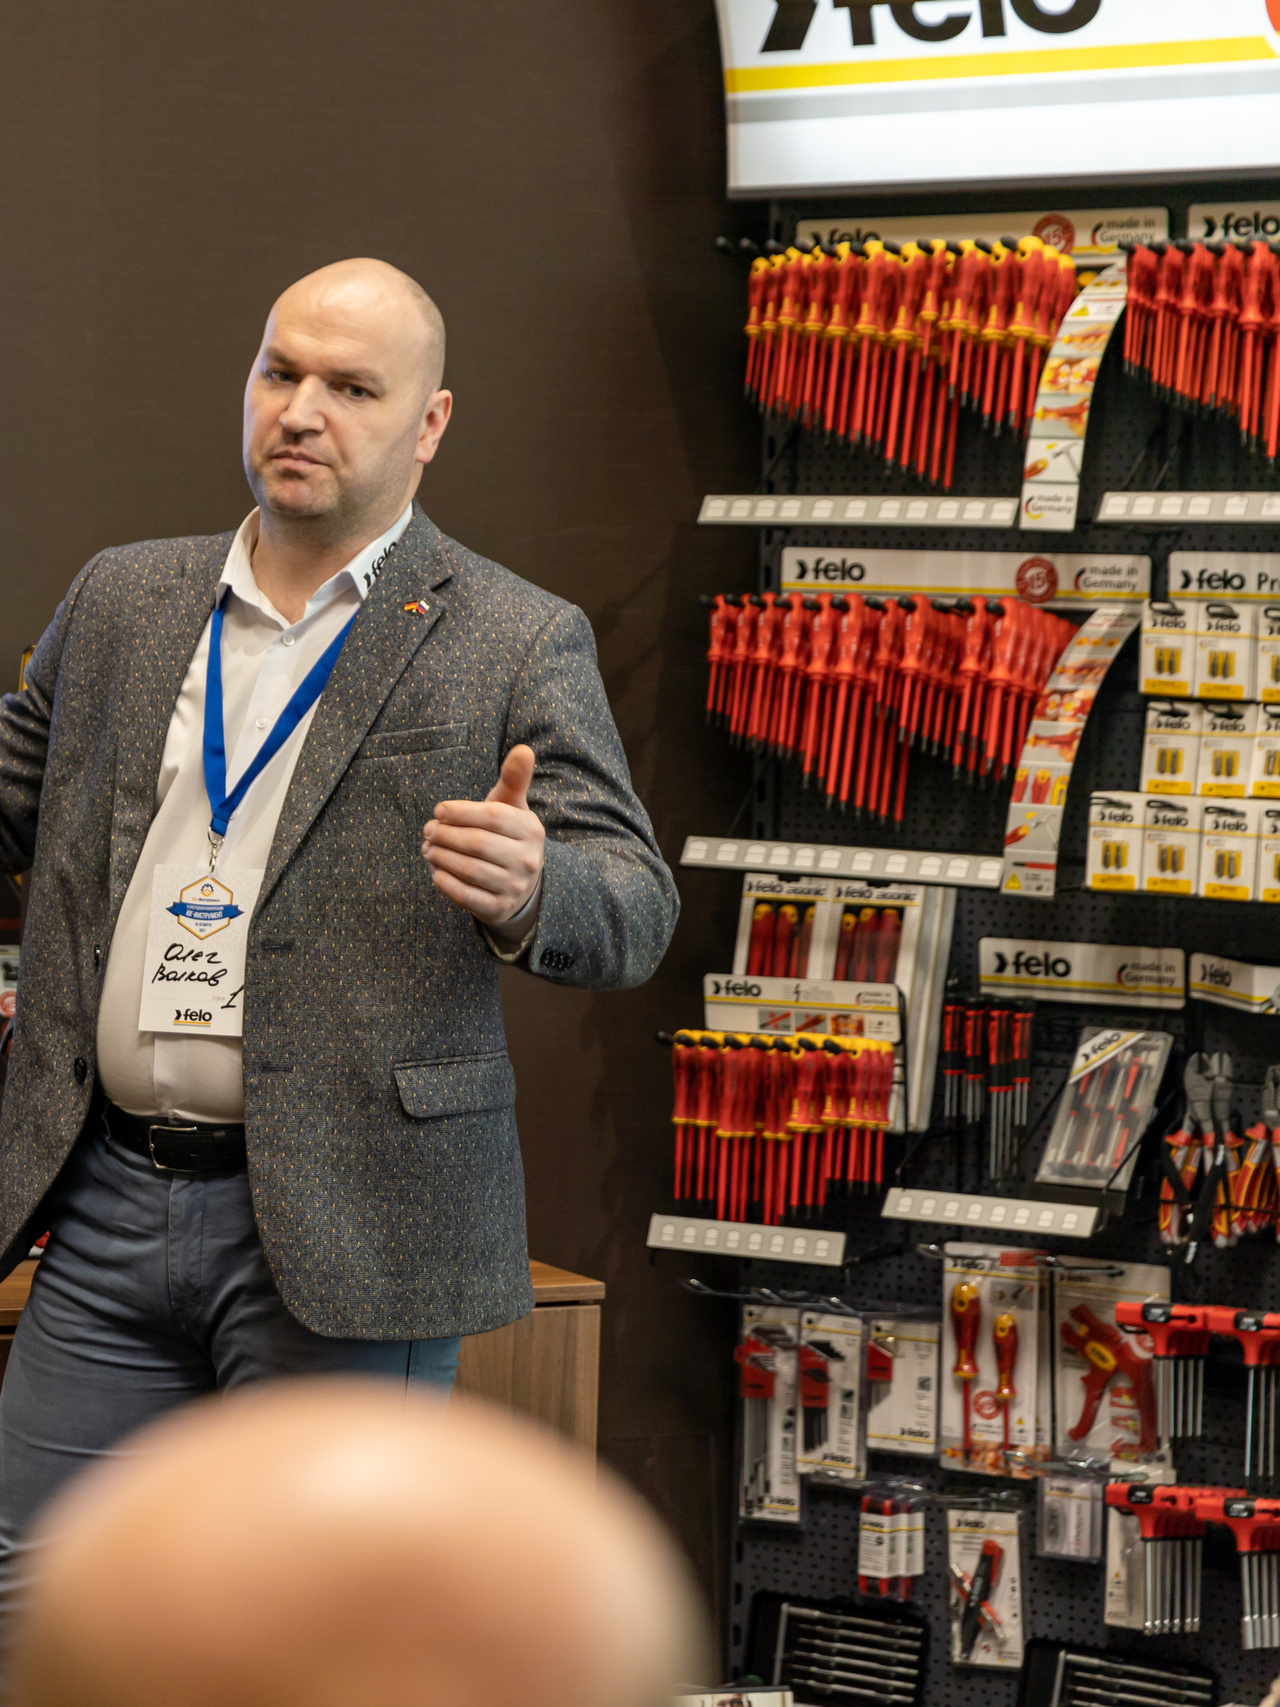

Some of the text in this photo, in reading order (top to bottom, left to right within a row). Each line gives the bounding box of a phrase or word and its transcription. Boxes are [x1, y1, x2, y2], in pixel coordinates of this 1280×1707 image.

[812, 557, 866, 582] felo
[1090, 564, 1138, 576] made in
[1083, 577, 1138, 591] Germany
[1197, 568, 1247, 591] felo
[1013, 952, 1071, 977] felo
[724, 979, 762, 998] felo
[183, 1008, 213, 1023] felo
